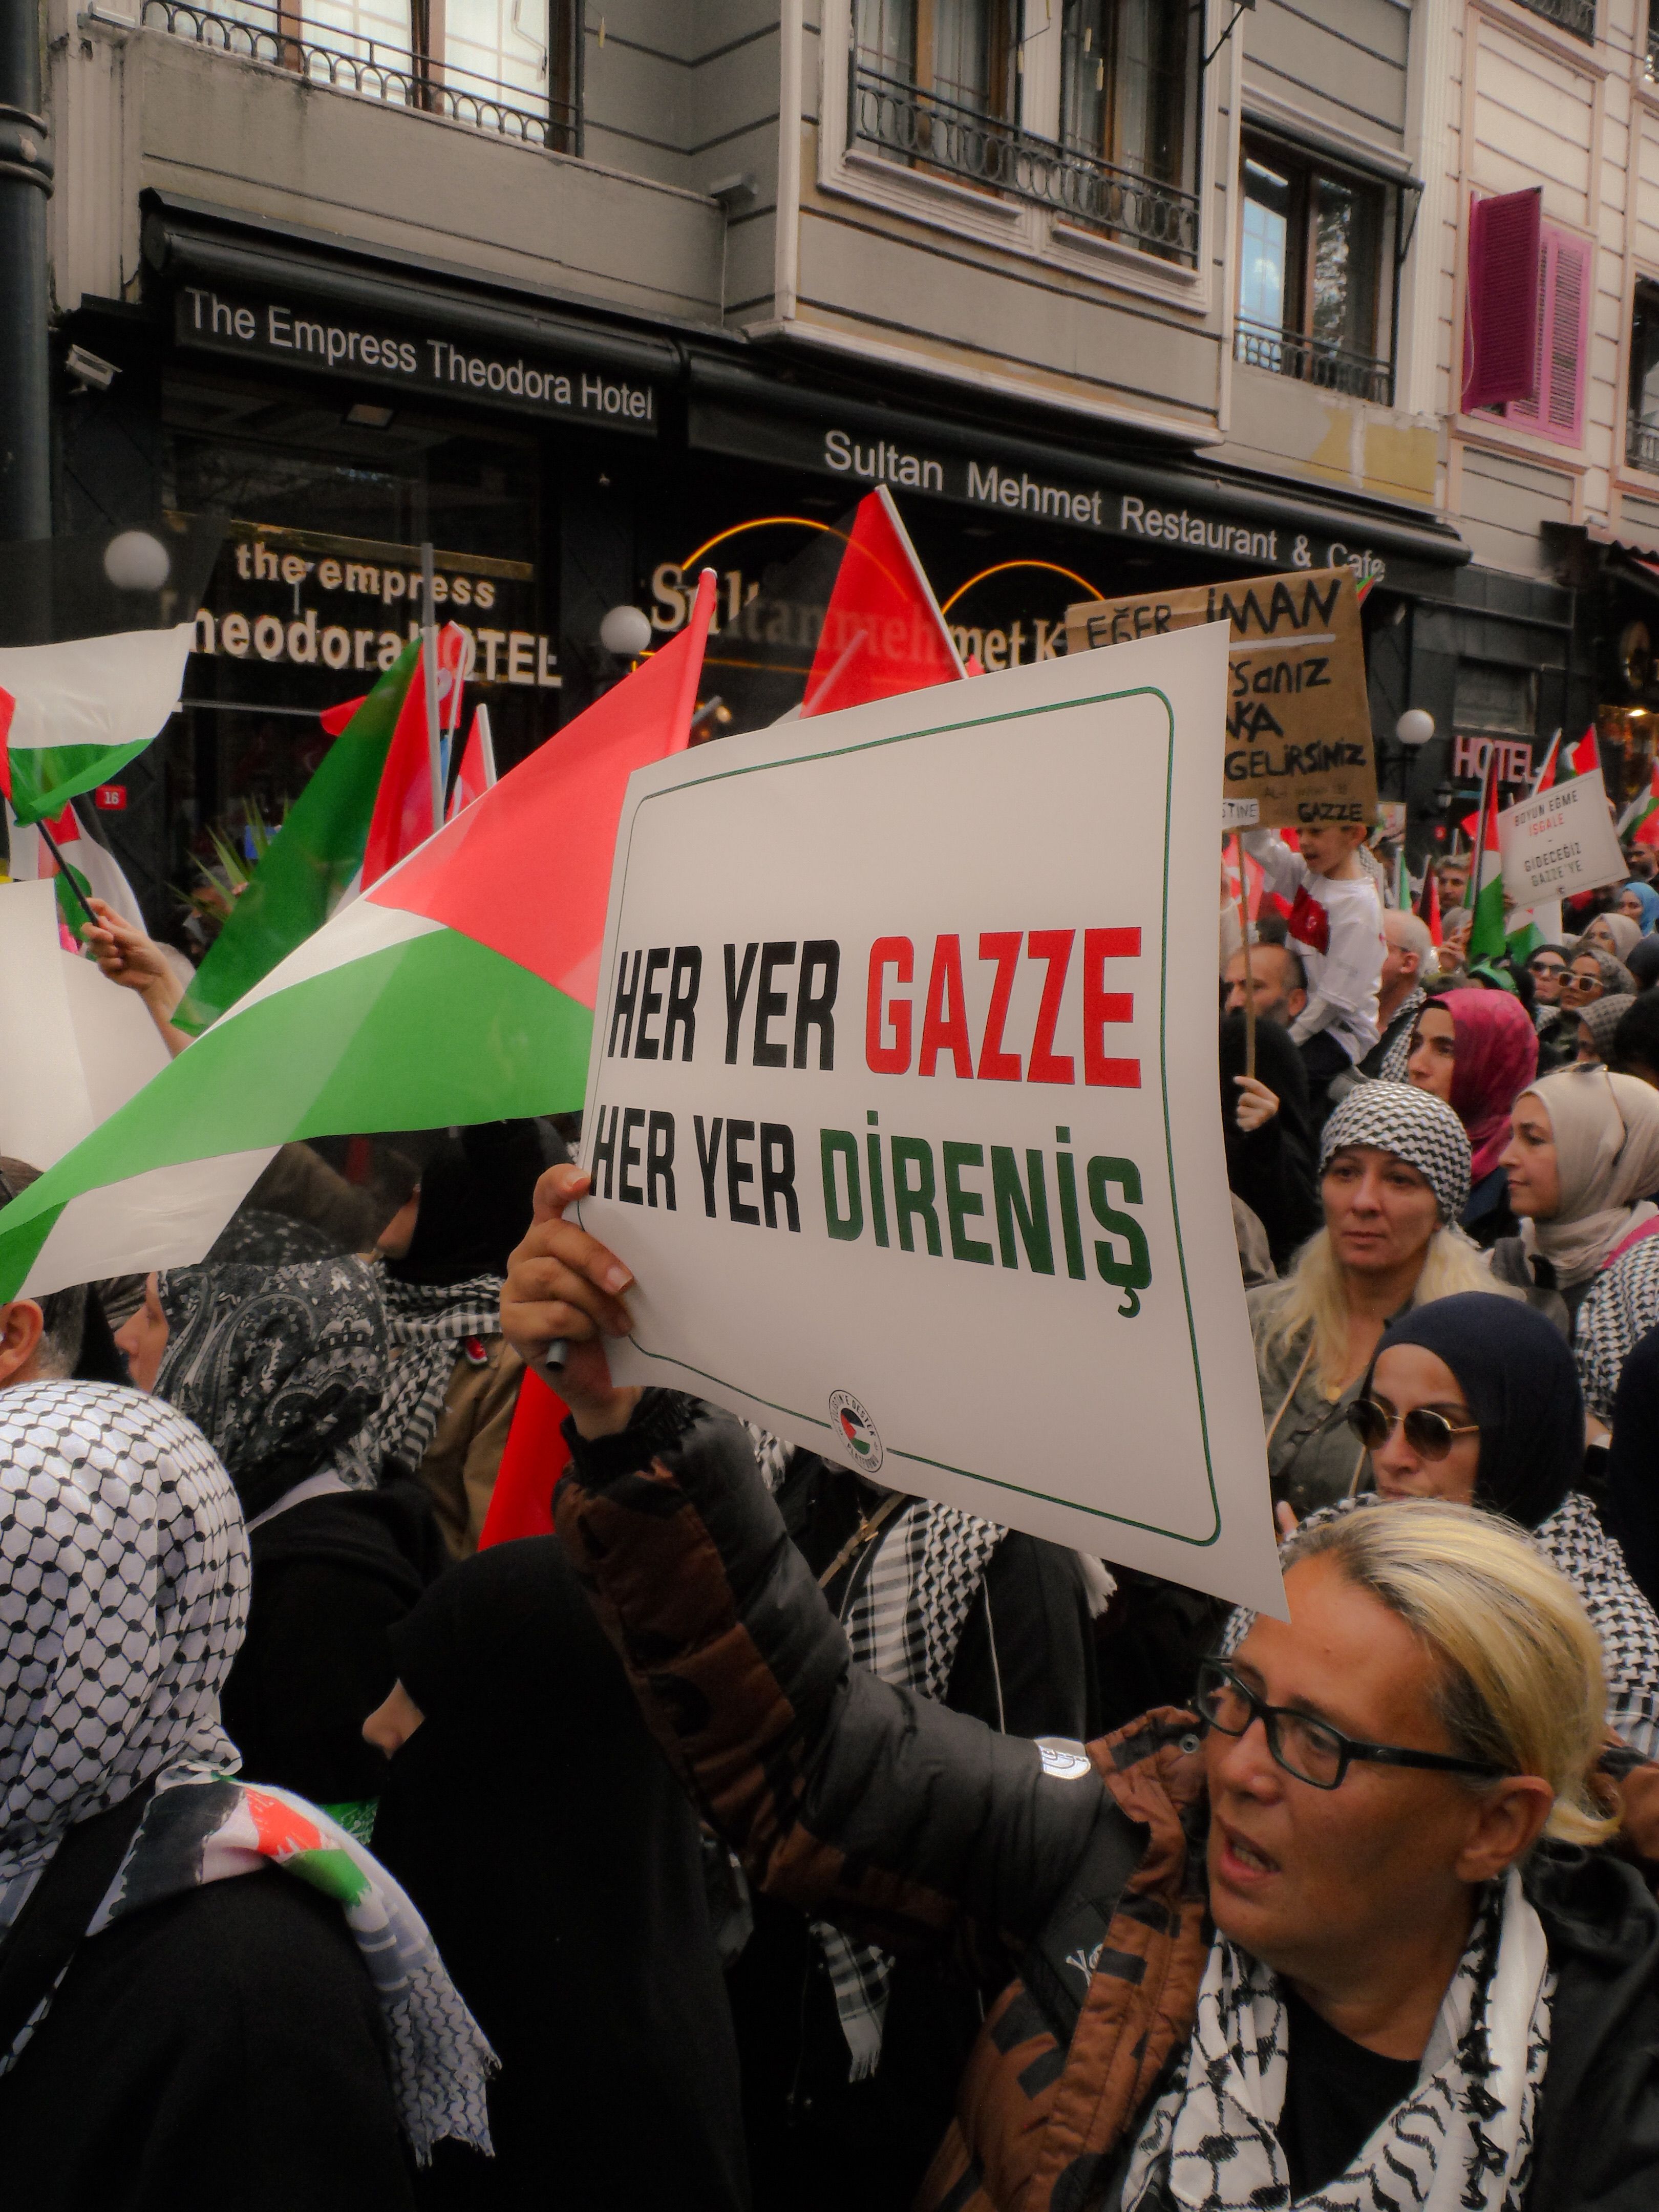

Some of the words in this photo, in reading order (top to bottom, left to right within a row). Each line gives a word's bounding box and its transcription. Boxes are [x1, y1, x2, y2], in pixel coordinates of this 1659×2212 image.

[186, 288, 255, 339] The
[268, 305, 416, 372] Empress
[427, 339, 571, 405] Theodora
[581, 373, 652, 419] Hotel
[825, 430, 943, 491] Sultan
[968, 460, 1101, 525] Mehmet
[1122, 497, 1278, 560] Restaurant
[1292, 536, 1312, 567] &
[1329, 543, 1386, 582] Cafe
[237, 541, 306, 584] the
[318, 559, 496, 609] empress
[105, 791, 119, 805] 16
[1454, 735, 1538, 784] HOTEL
[1298, 802, 1363, 823] GAZZE
[608, 946, 701, 1061] HER
[724, 940, 840, 1071] YER
[865, 927, 1142, 1088] GAZZE
[589, 1104, 676, 1211] HER
[692, 1115, 801, 1232] YER
[820, 1110, 1152, 1318] DİRENİŞ
